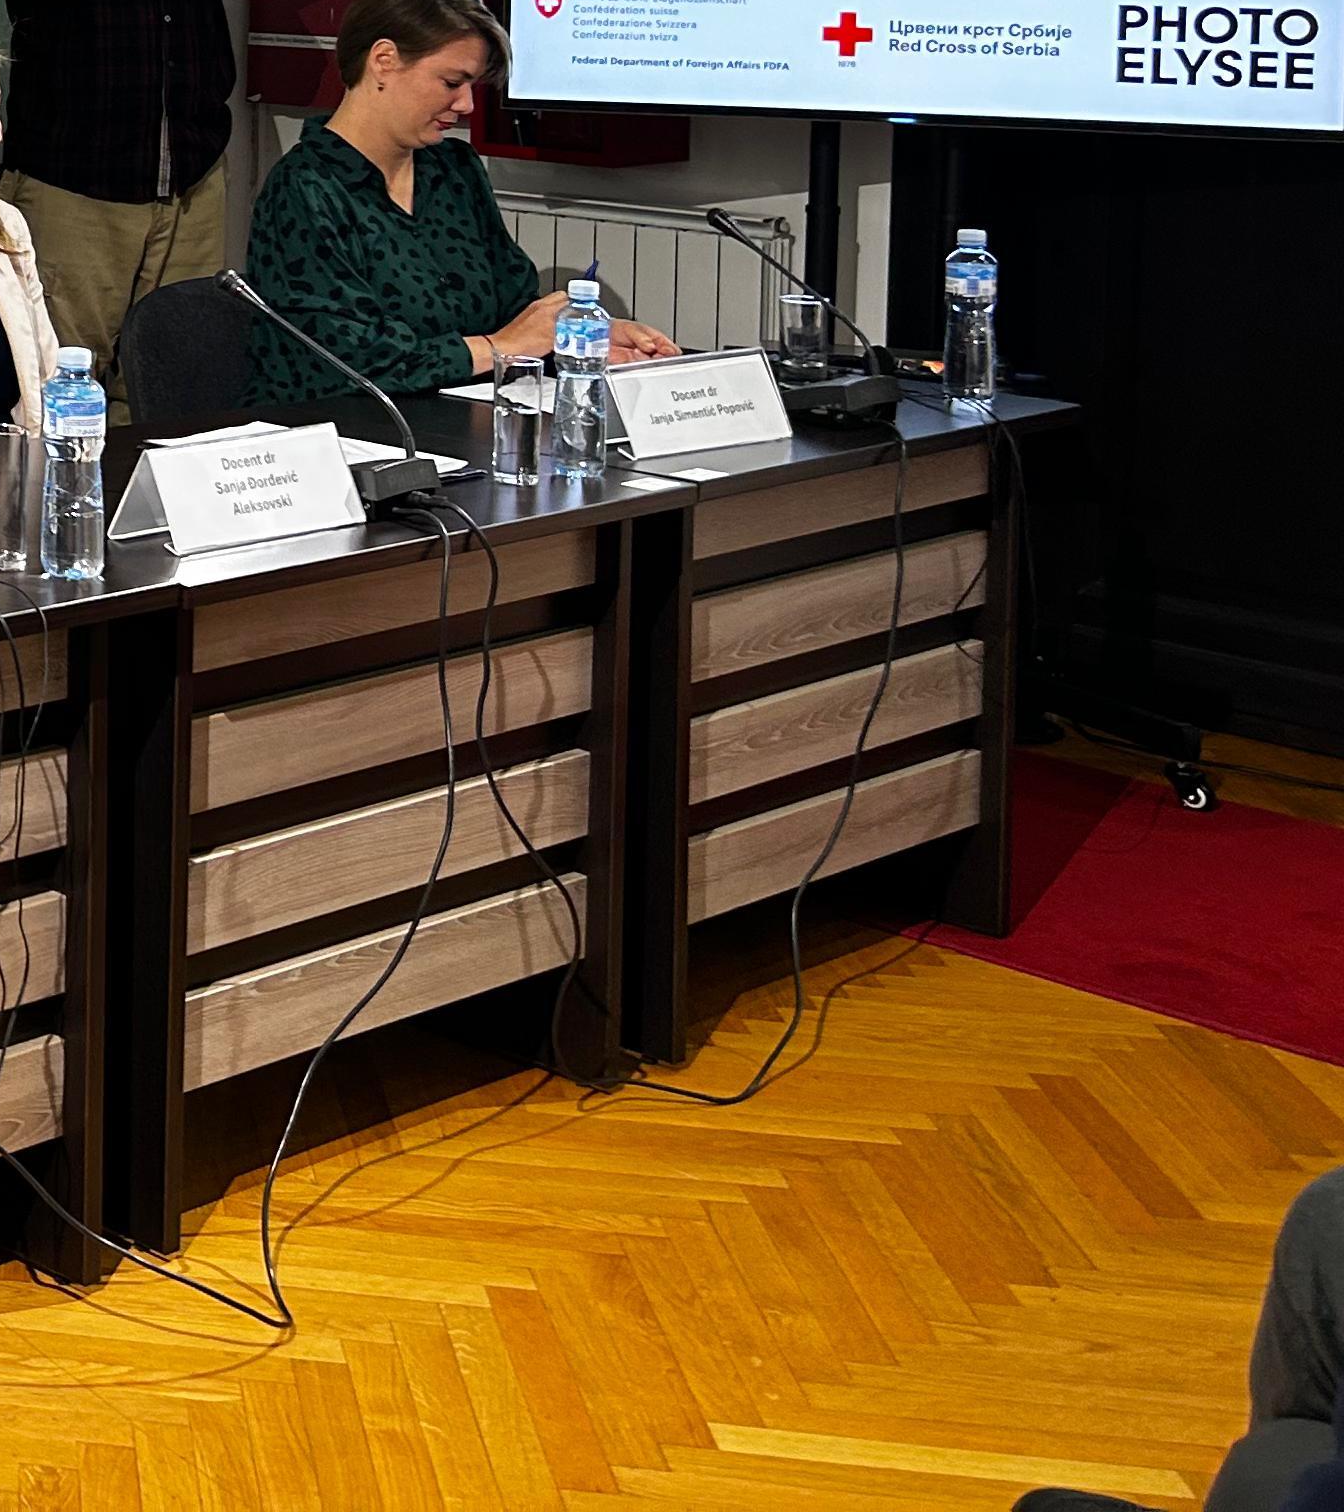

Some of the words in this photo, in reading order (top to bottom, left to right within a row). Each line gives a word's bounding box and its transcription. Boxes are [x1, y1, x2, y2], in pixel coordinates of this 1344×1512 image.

[649, 7, 679, 16] suisse
[573, 18, 652, 28] Confederazione
[655, 19, 697, 29] Svizzera
[889, 20, 958, 37] Црвени
[963, 25, 1004, 38] крст
[1008, 23, 1072, 41] Србије
[1117, 4, 1319, 47] PHOTO
[572, 30, 646, 40] Confederaziun
[649, 32, 678, 42] svizra
[889, 39, 921, 52] Red
[926, 39, 977, 54] Cross
[981, 41, 998, 54] of
[1002, 41, 1060, 56] Serbia
[571, 55, 607, 65] Federal
[610, 56, 669, 68] Department
[672, 58, 683, 67] of
[686, 59, 723, 70] Foreign
[726, 60, 761, 70] Affairs
[763, 61, 789, 71] FDFA
[1115, 47, 1314, 90] ELYSEE
[671, 388, 707, 402] Docent
[707, 386, 718, 398] dr
[221, 454, 263, 471] Docent
[263, 451, 276, 465] dr
[215, 479, 247, 495] Sanja
[248, 470, 299, 490] Đorđević
[232, 494, 293, 516] Aleksovski
